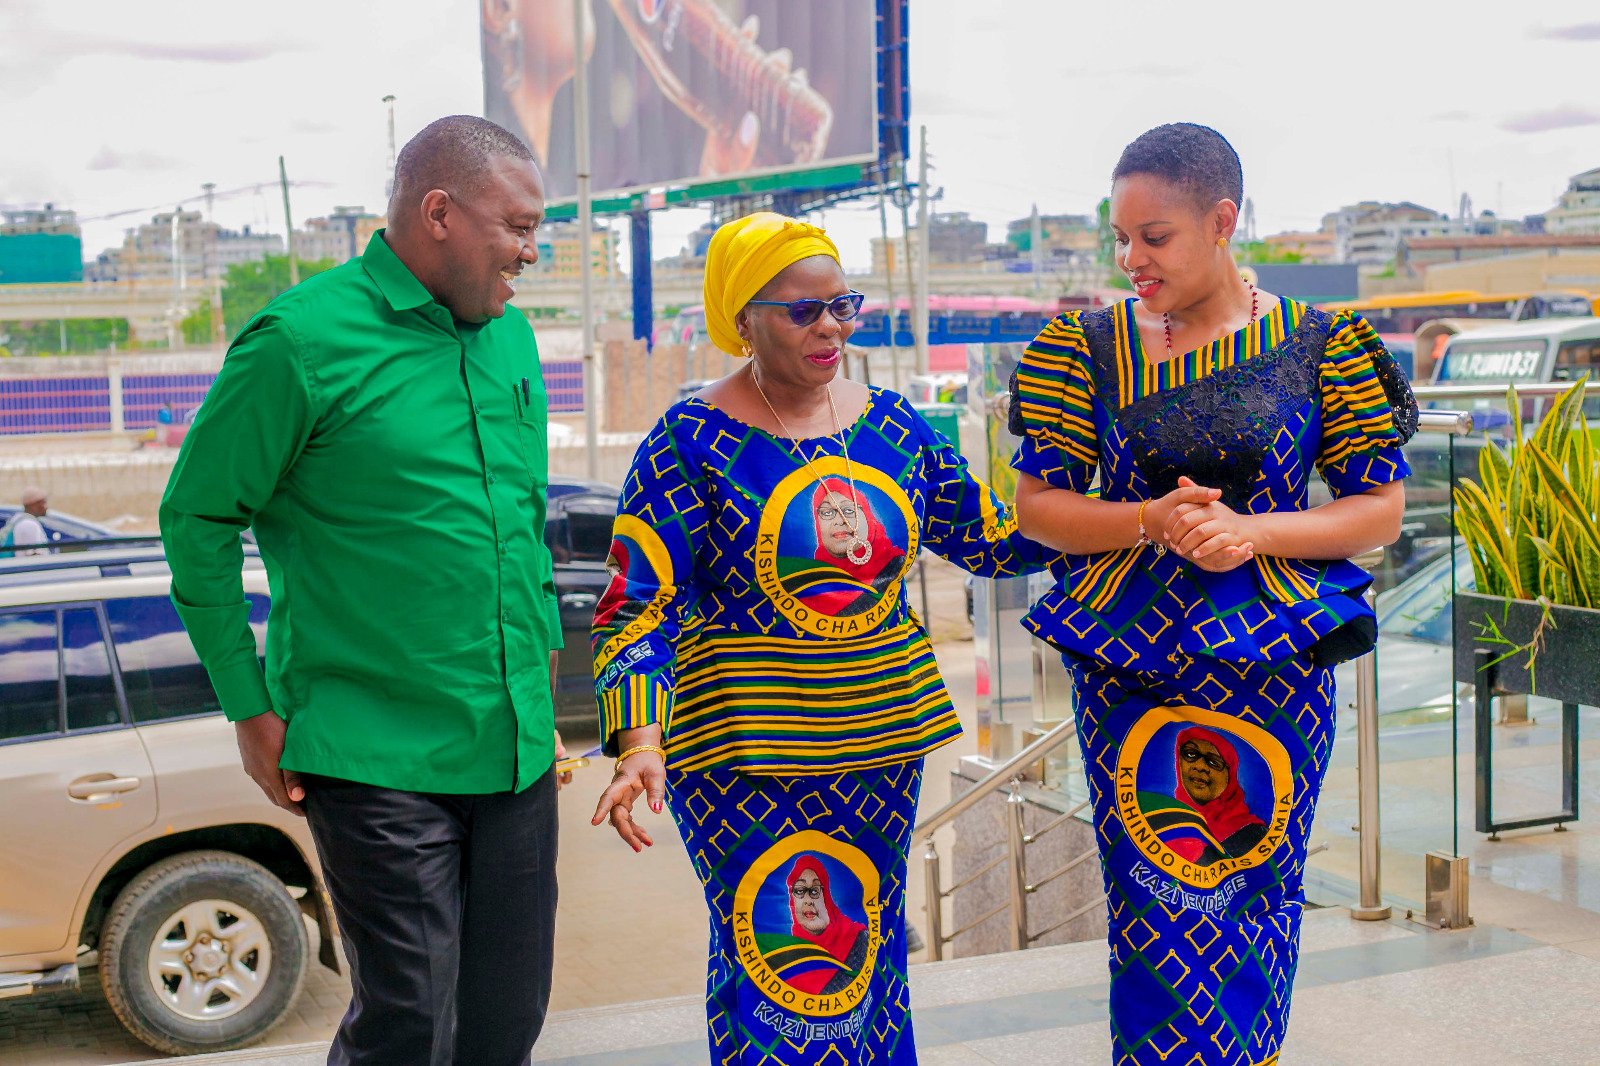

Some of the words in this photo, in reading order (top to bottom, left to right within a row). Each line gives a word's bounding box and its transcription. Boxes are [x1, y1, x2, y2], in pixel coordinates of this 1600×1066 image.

[759, 533, 808, 622] KISHINDO
[815, 618, 859, 634] CHA
[865, 588, 896, 626] RAIS
[604, 624, 643, 658] RAIS
[1120, 767, 1175, 867] KISHINDO
[1258, 793, 1291, 857] SAMIA
[1129, 861, 1180, 905] KAZI
[735, 911, 796, 1004] KISHINDO
[803, 997, 843, 1012] CHA
[845, 966, 872, 1003] RAIS
[866, 896, 878, 960] SAMIA
[753, 1001, 804, 1037] KAZI
